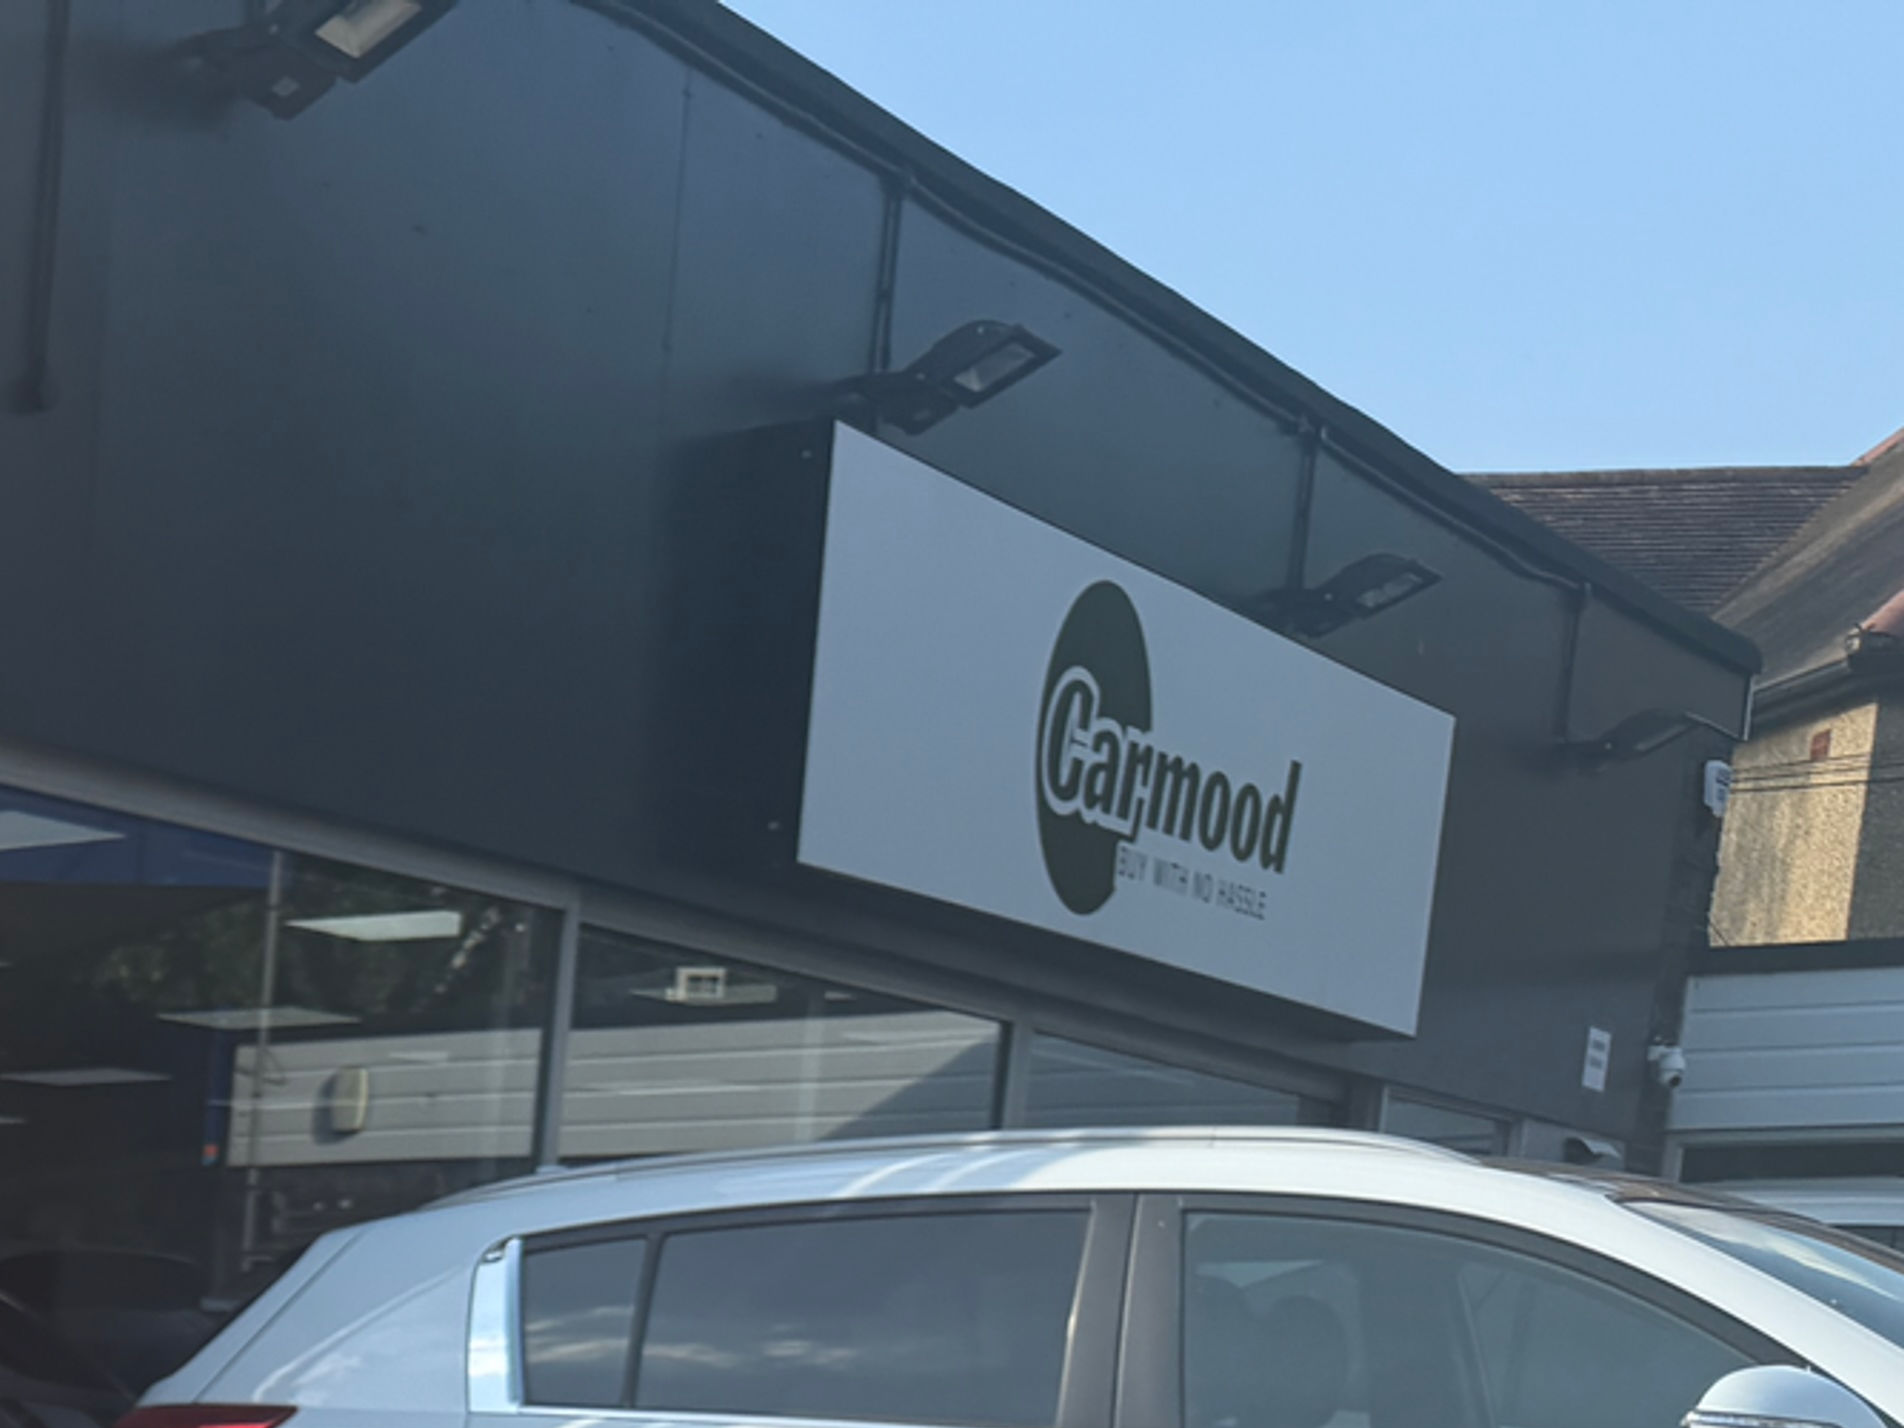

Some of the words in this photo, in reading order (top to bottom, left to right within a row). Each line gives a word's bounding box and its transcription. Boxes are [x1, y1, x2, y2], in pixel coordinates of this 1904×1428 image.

[1047, 679, 1302, 874] Carmood
[1118, 846, 1149, 881] BUY
[1152, 856, 1190, 896] WITH
[1192, 871, 1214, 904] NO
[1216, 879, 1266, 920] HASSLE
